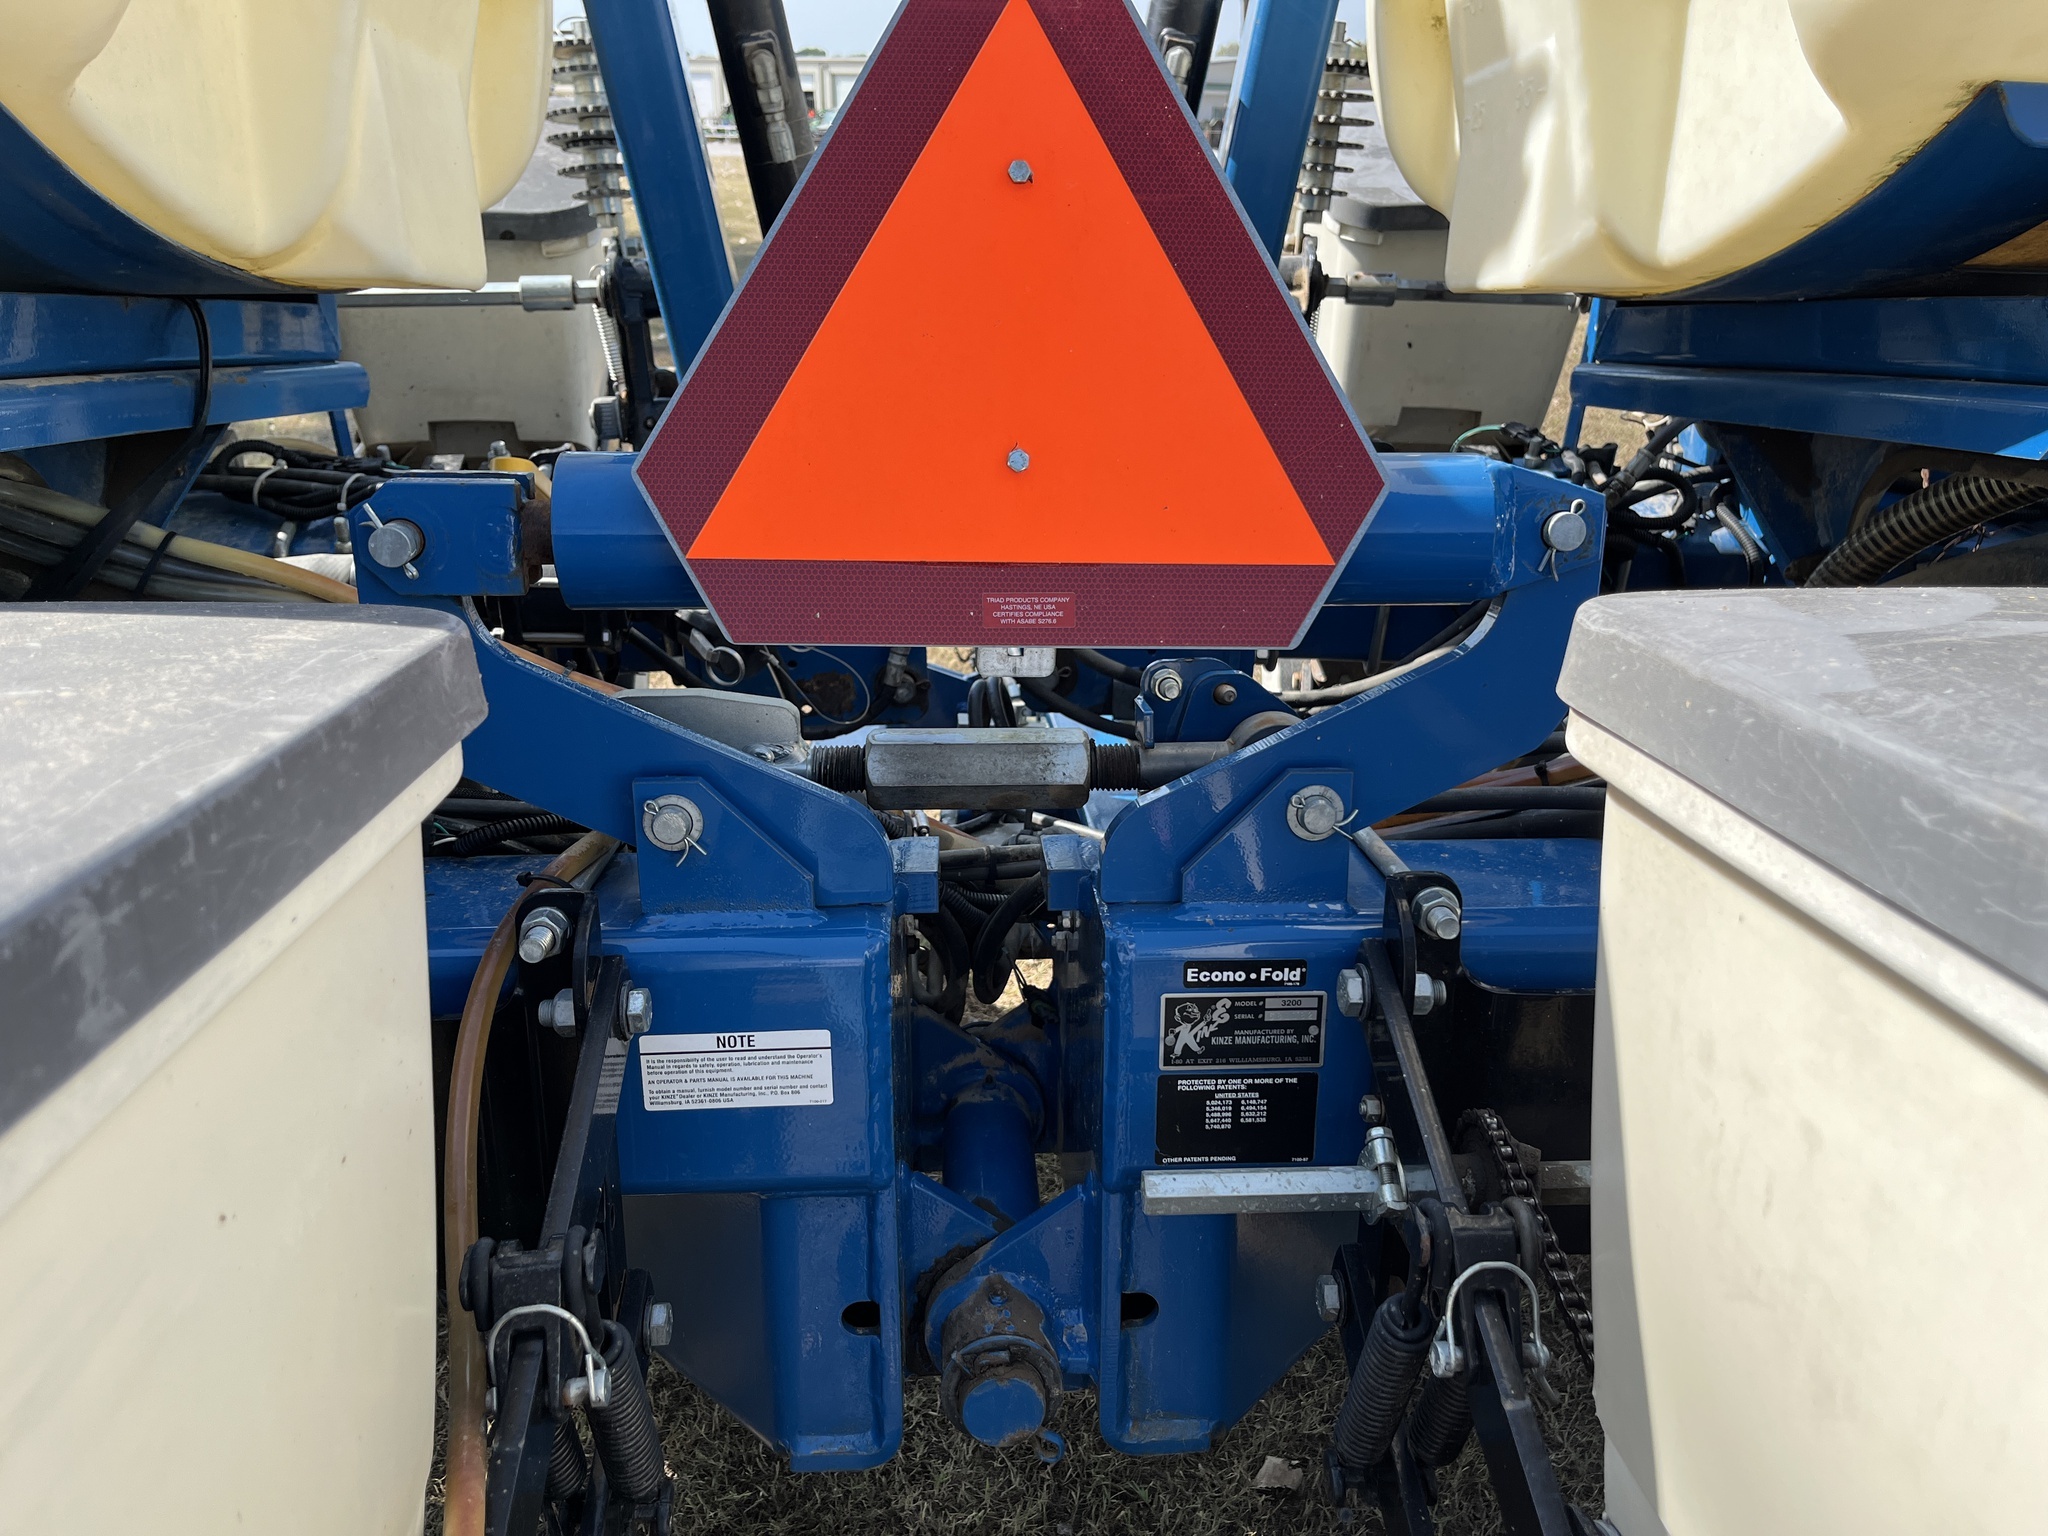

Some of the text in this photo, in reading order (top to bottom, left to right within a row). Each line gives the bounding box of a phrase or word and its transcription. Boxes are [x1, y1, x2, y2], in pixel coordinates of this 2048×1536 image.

[1187, 967, 1301, 982] Econo Fold
[716, 1035, 755, 1049] NOTE
[1211, 1035, 1316, 1045] KINZE MANUFACTURING, INC.
